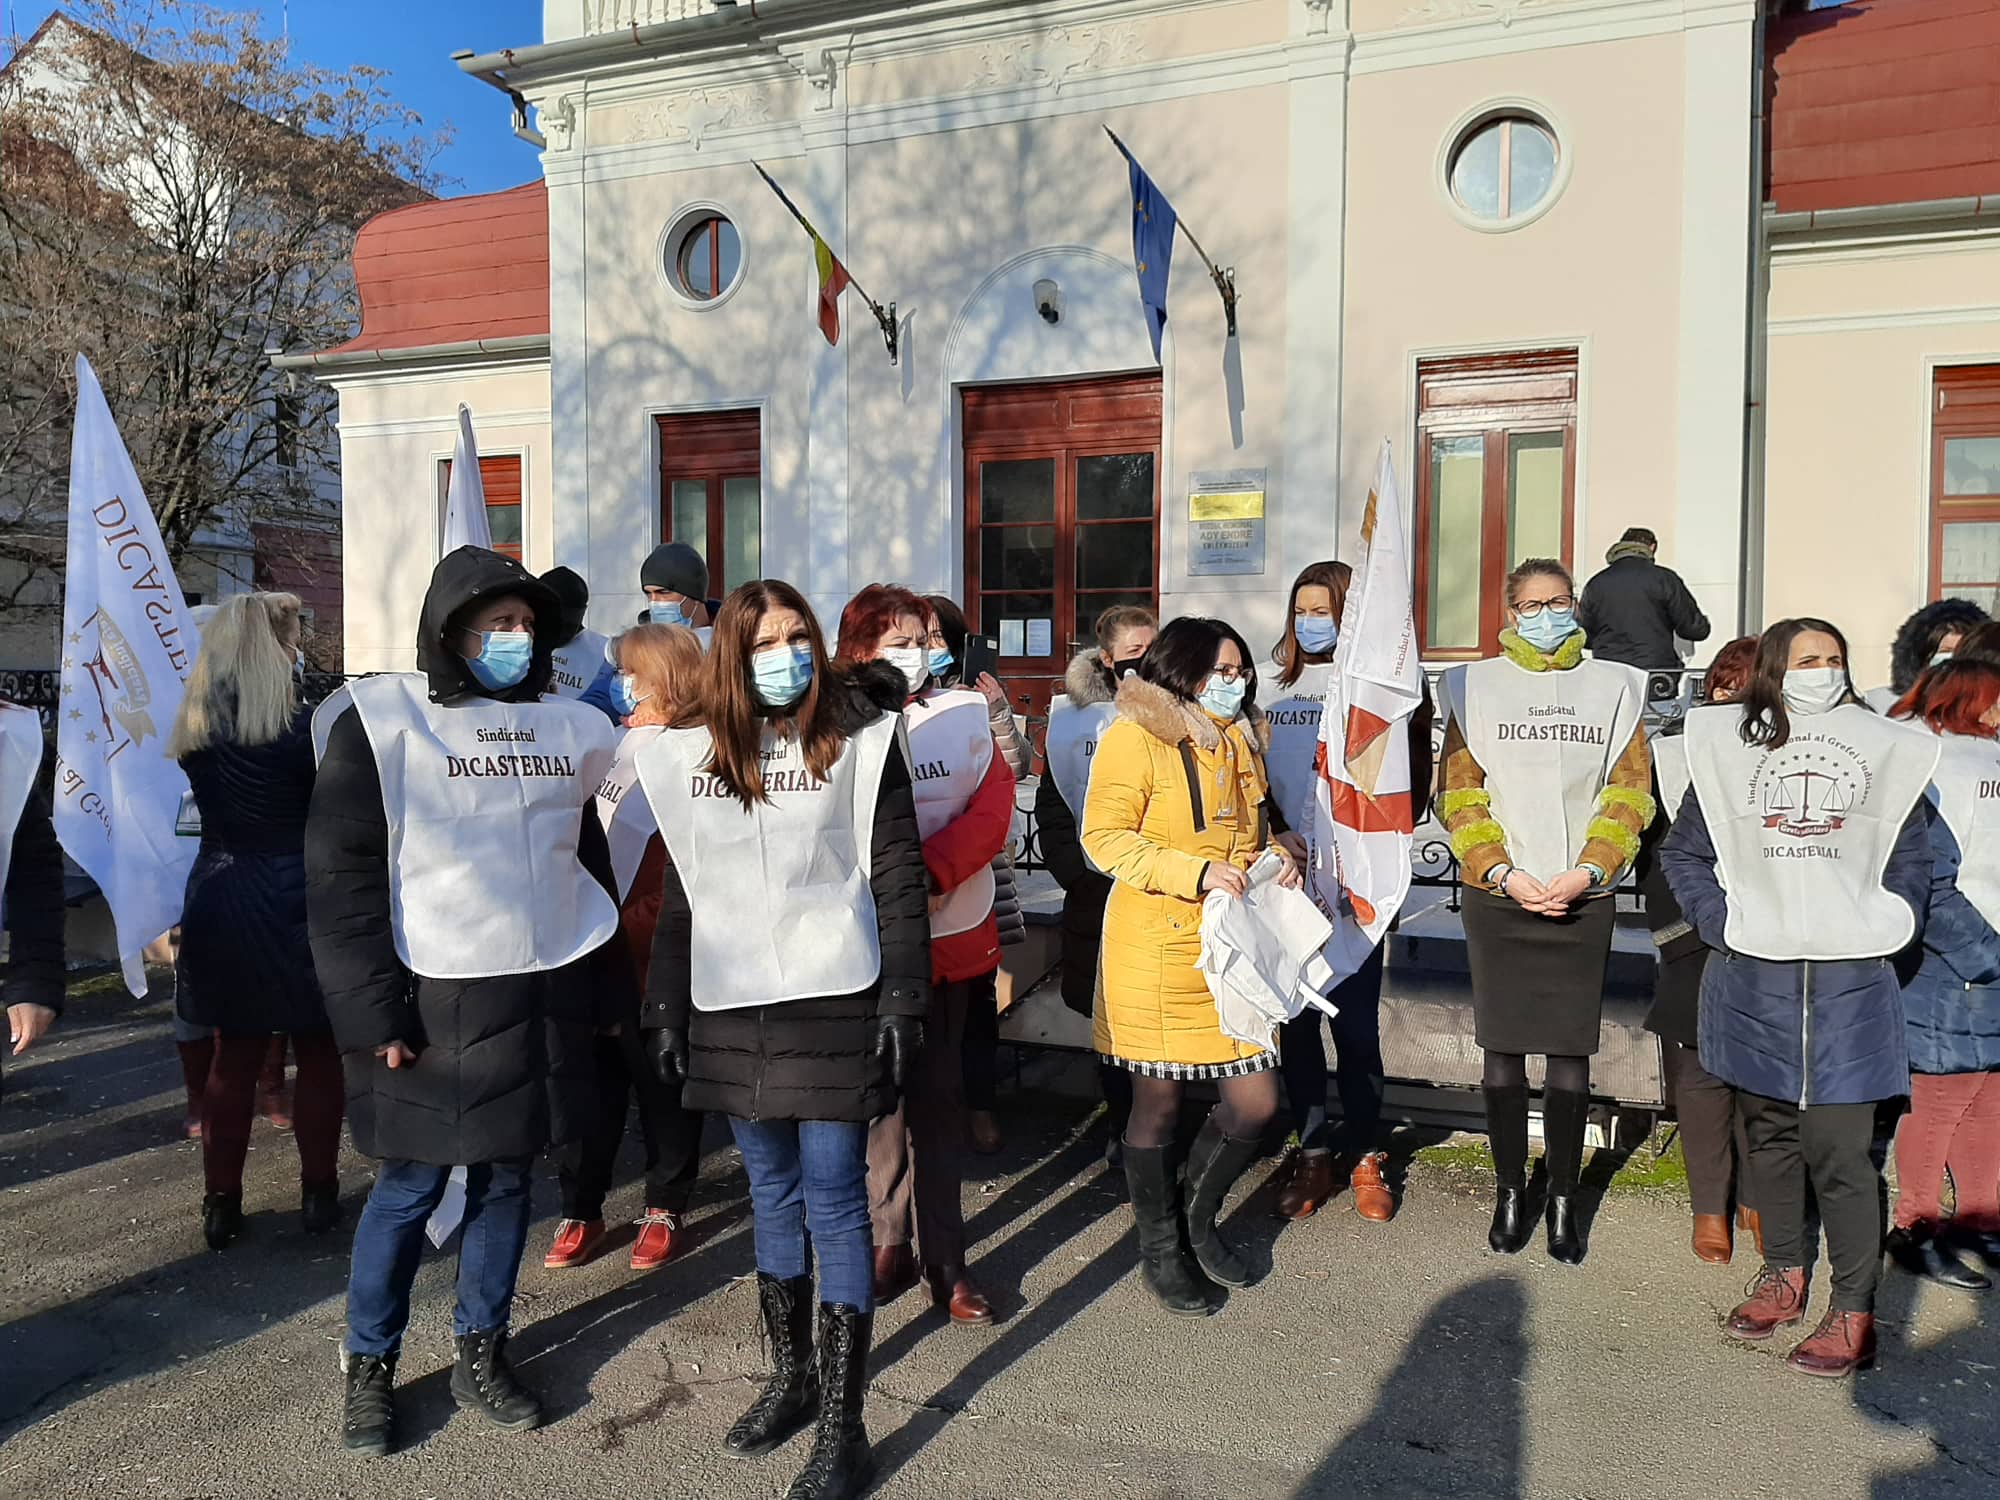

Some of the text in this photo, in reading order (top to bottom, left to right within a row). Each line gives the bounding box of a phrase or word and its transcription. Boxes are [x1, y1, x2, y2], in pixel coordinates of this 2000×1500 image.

[1200, 529, 1254, 540] ADY ENDRE
[552, 669, 583, 690] ERIAL
[1527, 704, 1577, 717] Sindicatul
[476, 727, 536, 743] Sindicatul
[1497, 722, 1605, 745] DICASTERIAL
[1814, 733, 1825, 742] al
[446, 754, 576, 778] DICASTERIAL
